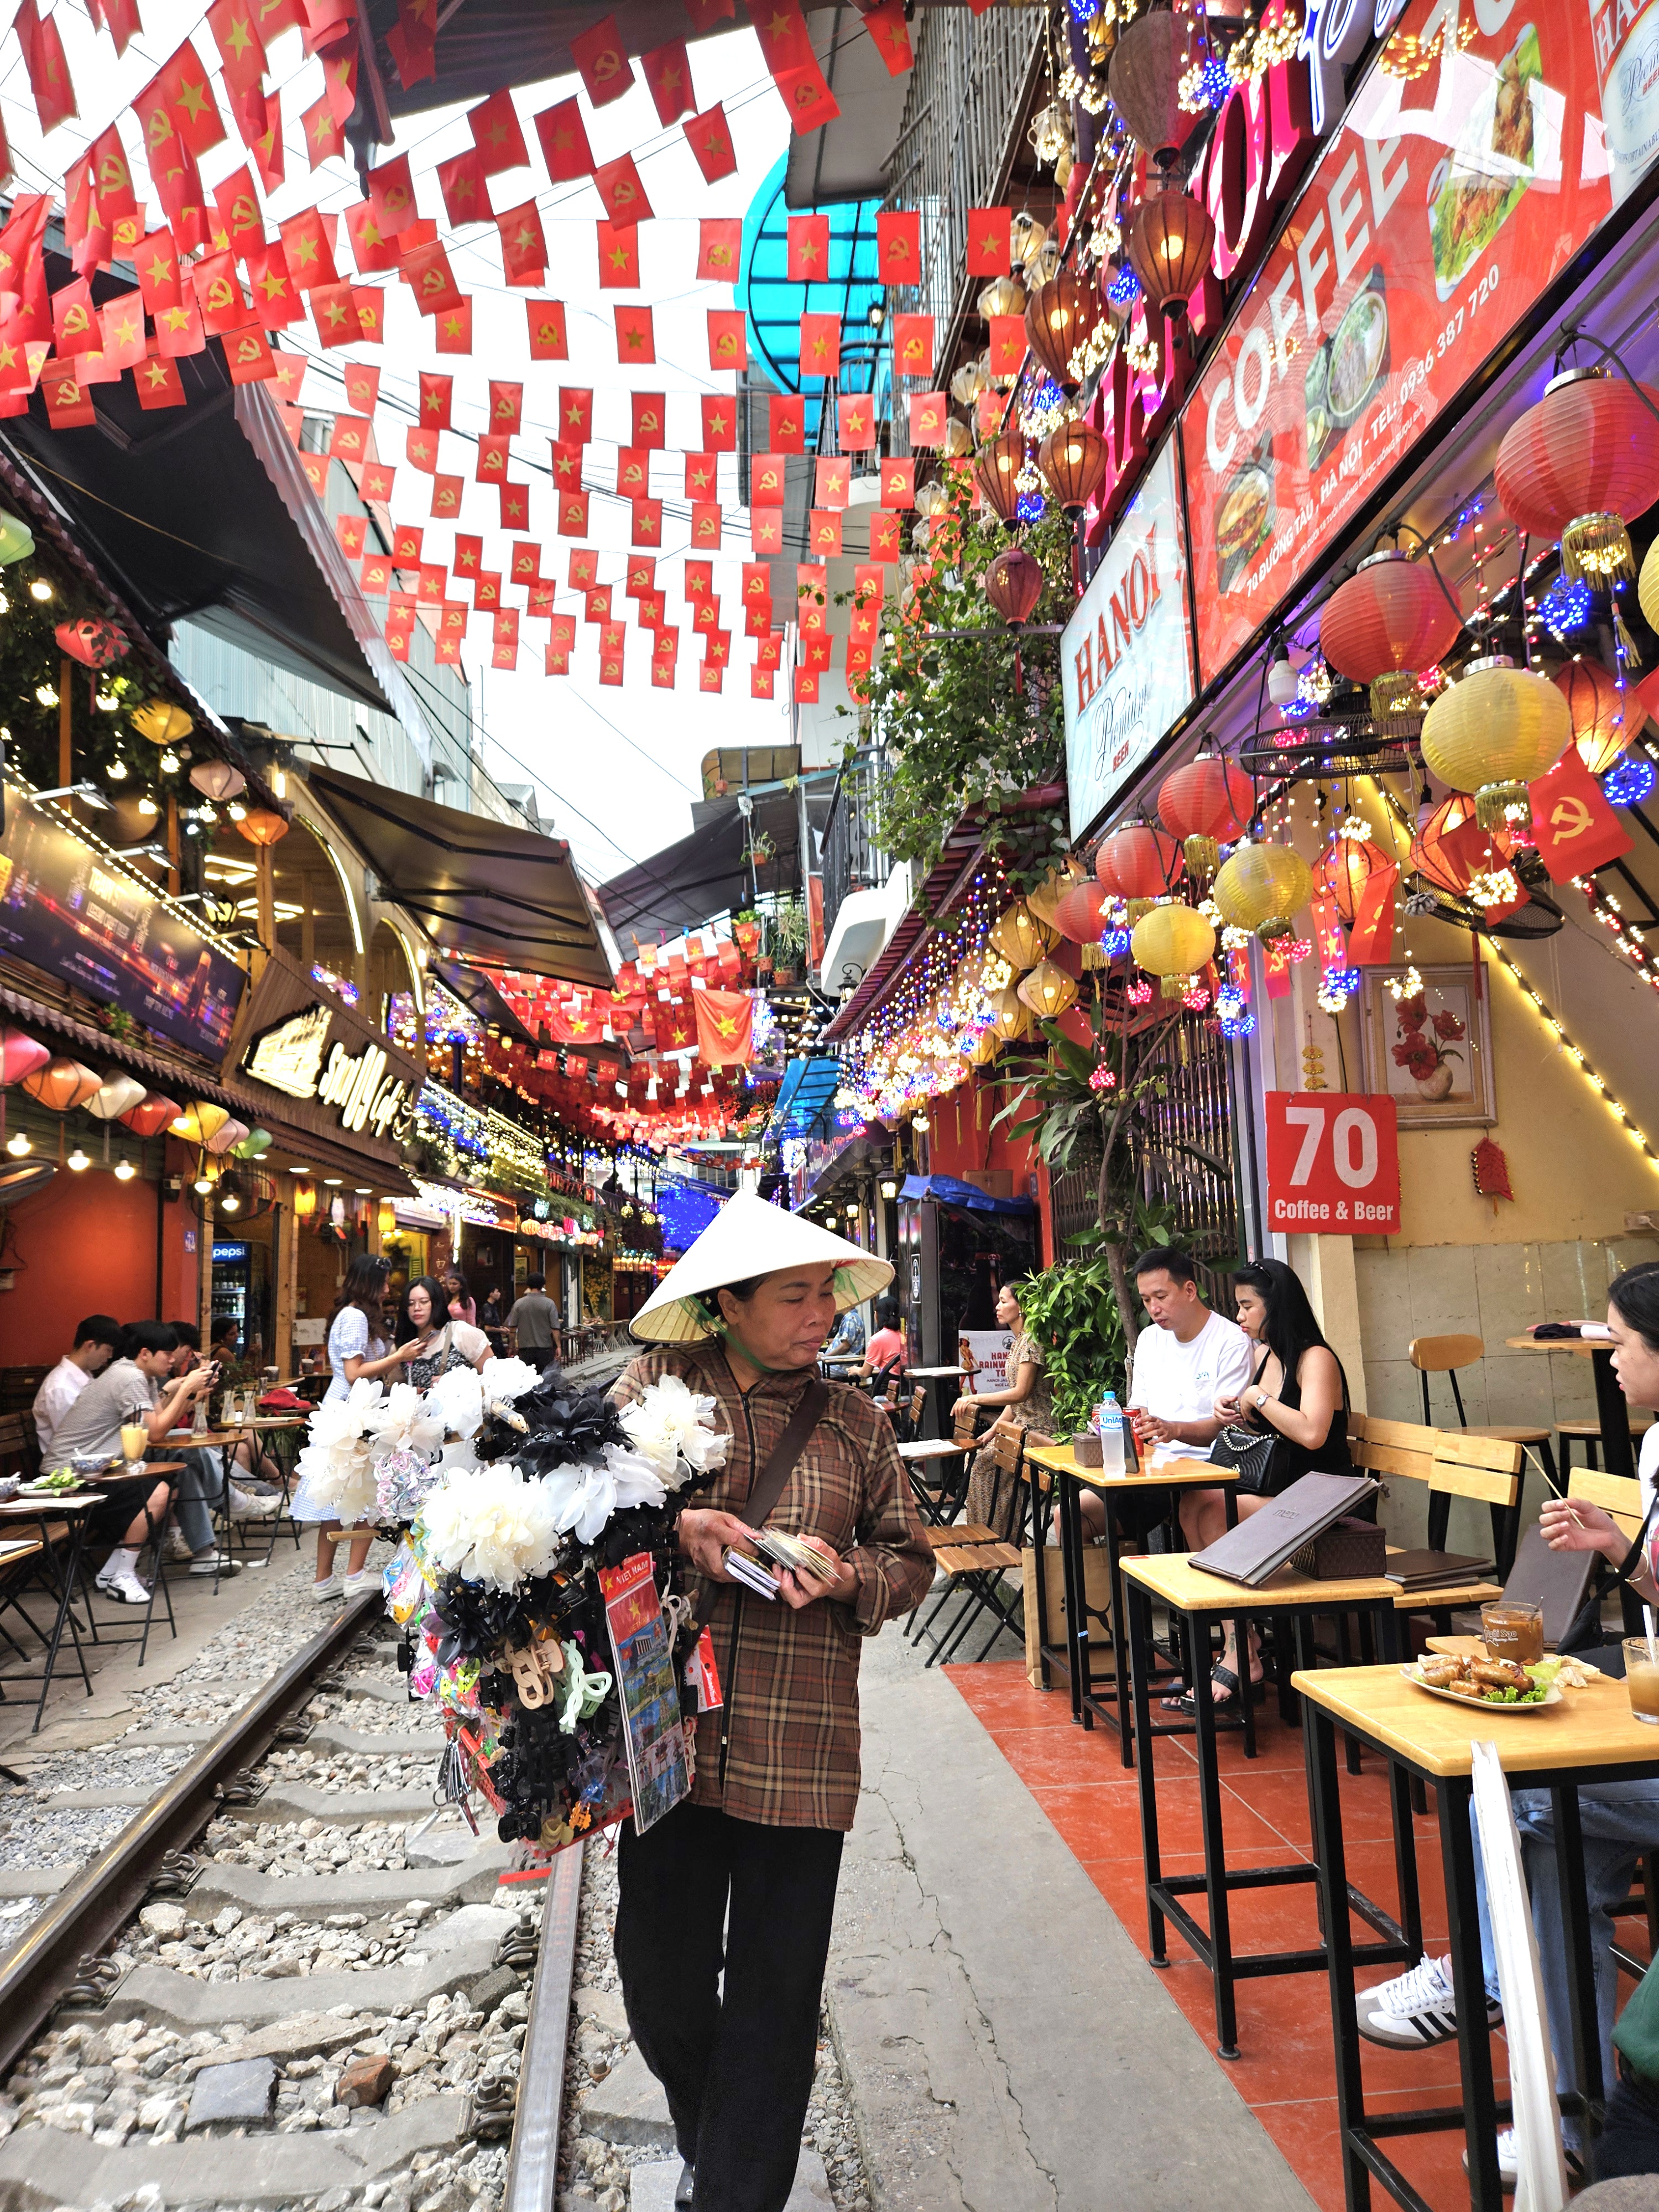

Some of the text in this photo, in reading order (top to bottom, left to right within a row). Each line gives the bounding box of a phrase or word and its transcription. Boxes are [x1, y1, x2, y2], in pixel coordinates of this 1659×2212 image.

[1597, 0, 1651, 75] HA
[1627, 128, 1659, 164] OBTAINABL
[1206, 82, 1409, 474] COFFEE
[1246, 571, 1259, 598] 70
[1320, 468, 1338, 505] HÀ
[1338, 439, 1363, 482] NỘI
[1370, 400, 1397, 441] TEL:
[1400, 348, 1434, 405] 0936
[1437, 306, 1464, 358] 387
[1468, 264, 1500, 318] 720
[1074, 521, 1161, 718] HANOI
[1112, 740, 1130, 774] BEER
[1285, 1107, 1378, 1188] 70
[1275, 1199, 1394, 1220] Coffee & Beer
[213, 1246, 246, 1259] pepsi
[992, 1352, 1010, 1360] HAN
[632, 1559, 649, 1575] NAM
